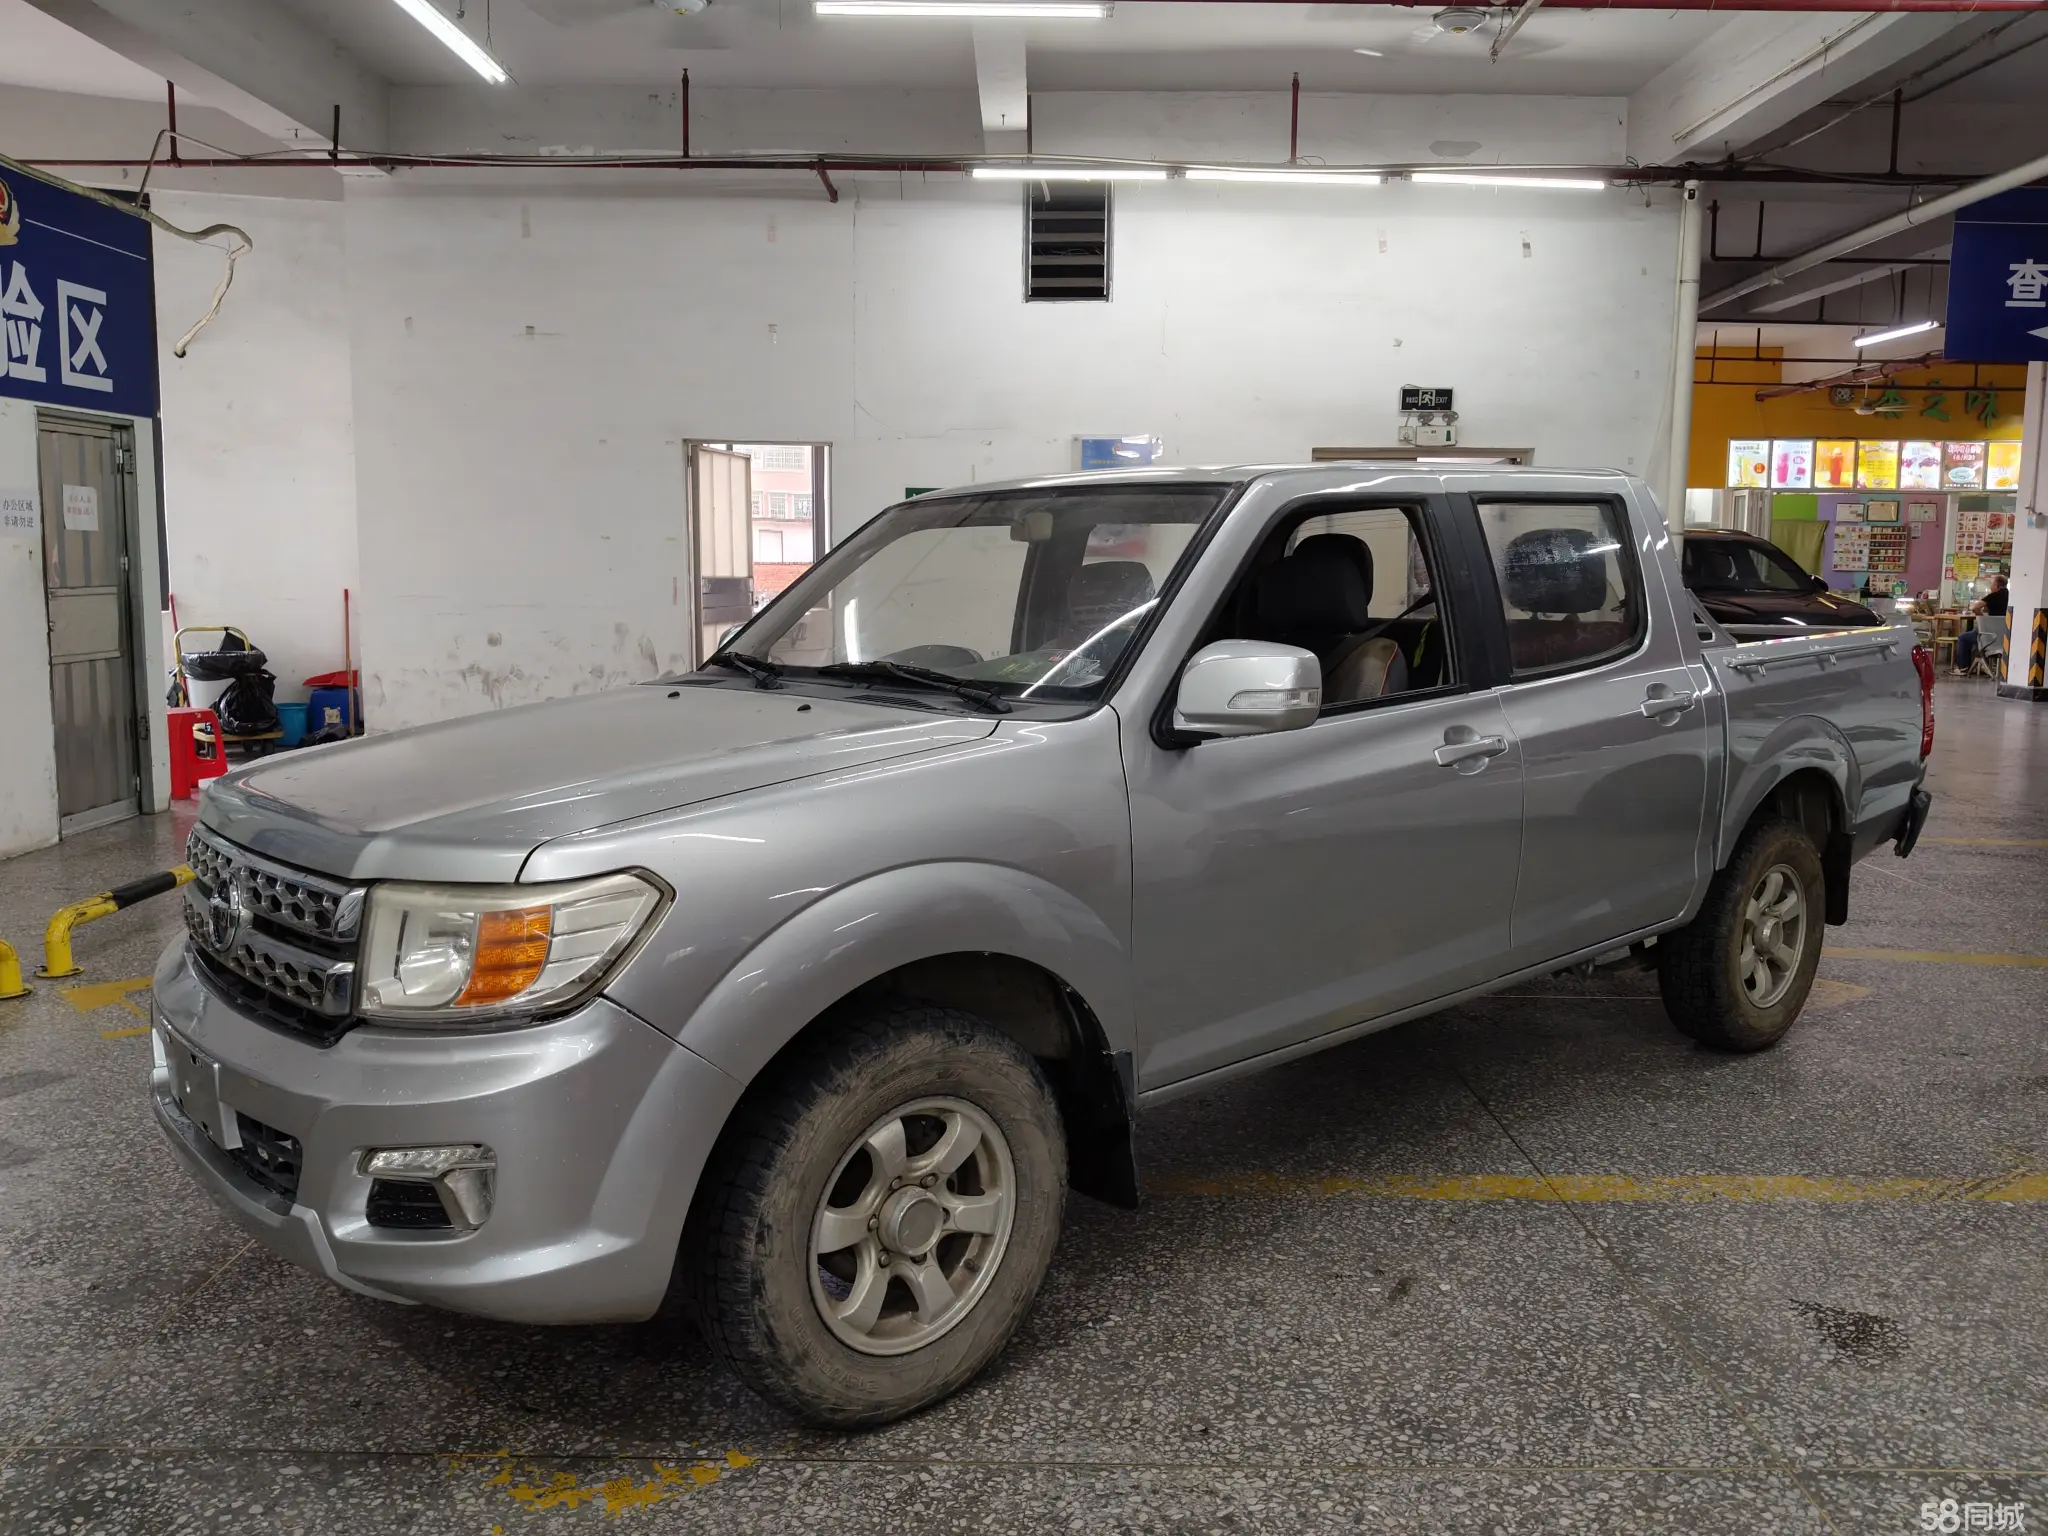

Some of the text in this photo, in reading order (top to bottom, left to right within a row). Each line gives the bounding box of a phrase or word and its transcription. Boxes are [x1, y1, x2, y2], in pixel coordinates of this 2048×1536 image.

[2005, 258, 2048, 308] 查
[1435, 396, 1448, 404] EXIT
[3, 499, 34, 512] 办公区域
